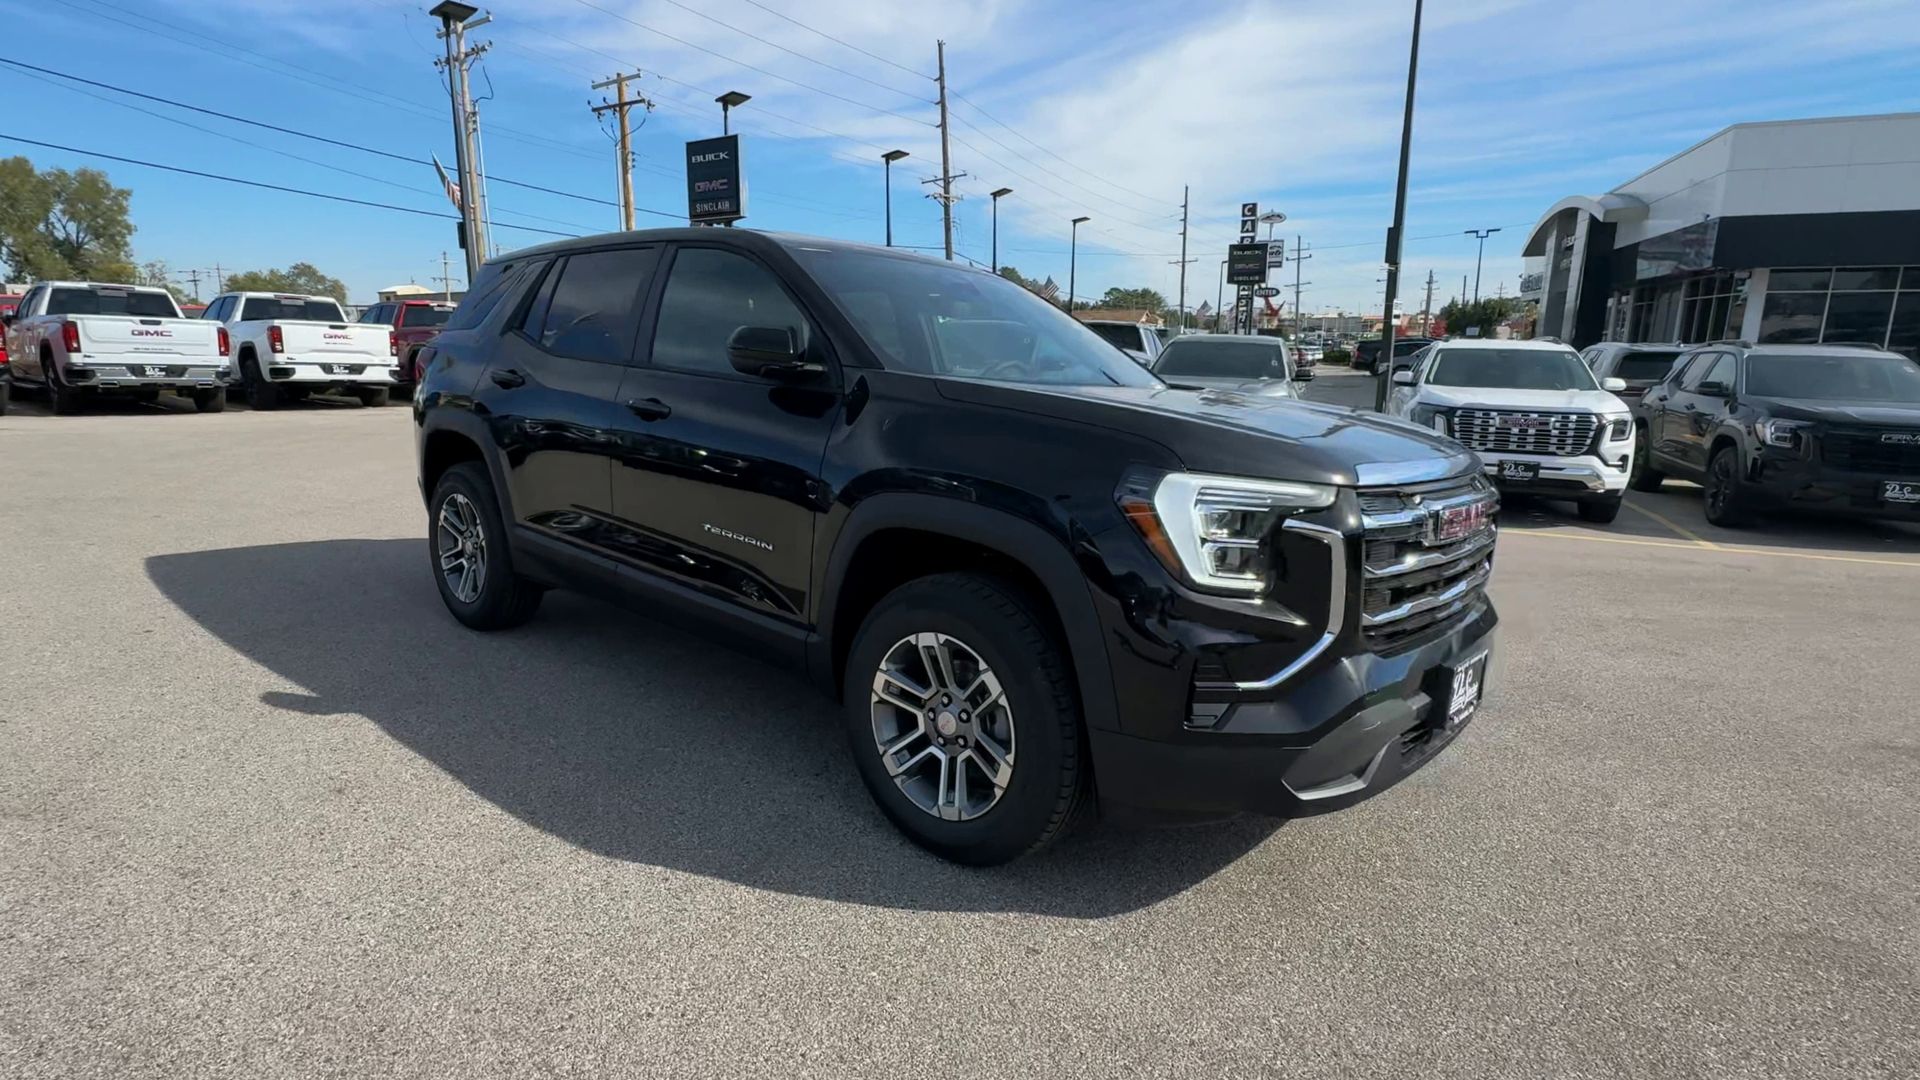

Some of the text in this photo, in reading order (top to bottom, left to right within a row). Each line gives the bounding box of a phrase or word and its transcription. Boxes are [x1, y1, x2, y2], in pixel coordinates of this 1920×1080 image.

[692, 151, 730, 163] BUICK
[695, 179, 728, 192] GMC
[696, 201, 730, 212] SINCLAIR
[131, 329, 173, 337] GMC
[1881, 433, 1920, 445] GM
[702, 523, 773, 551] TERRAIN
